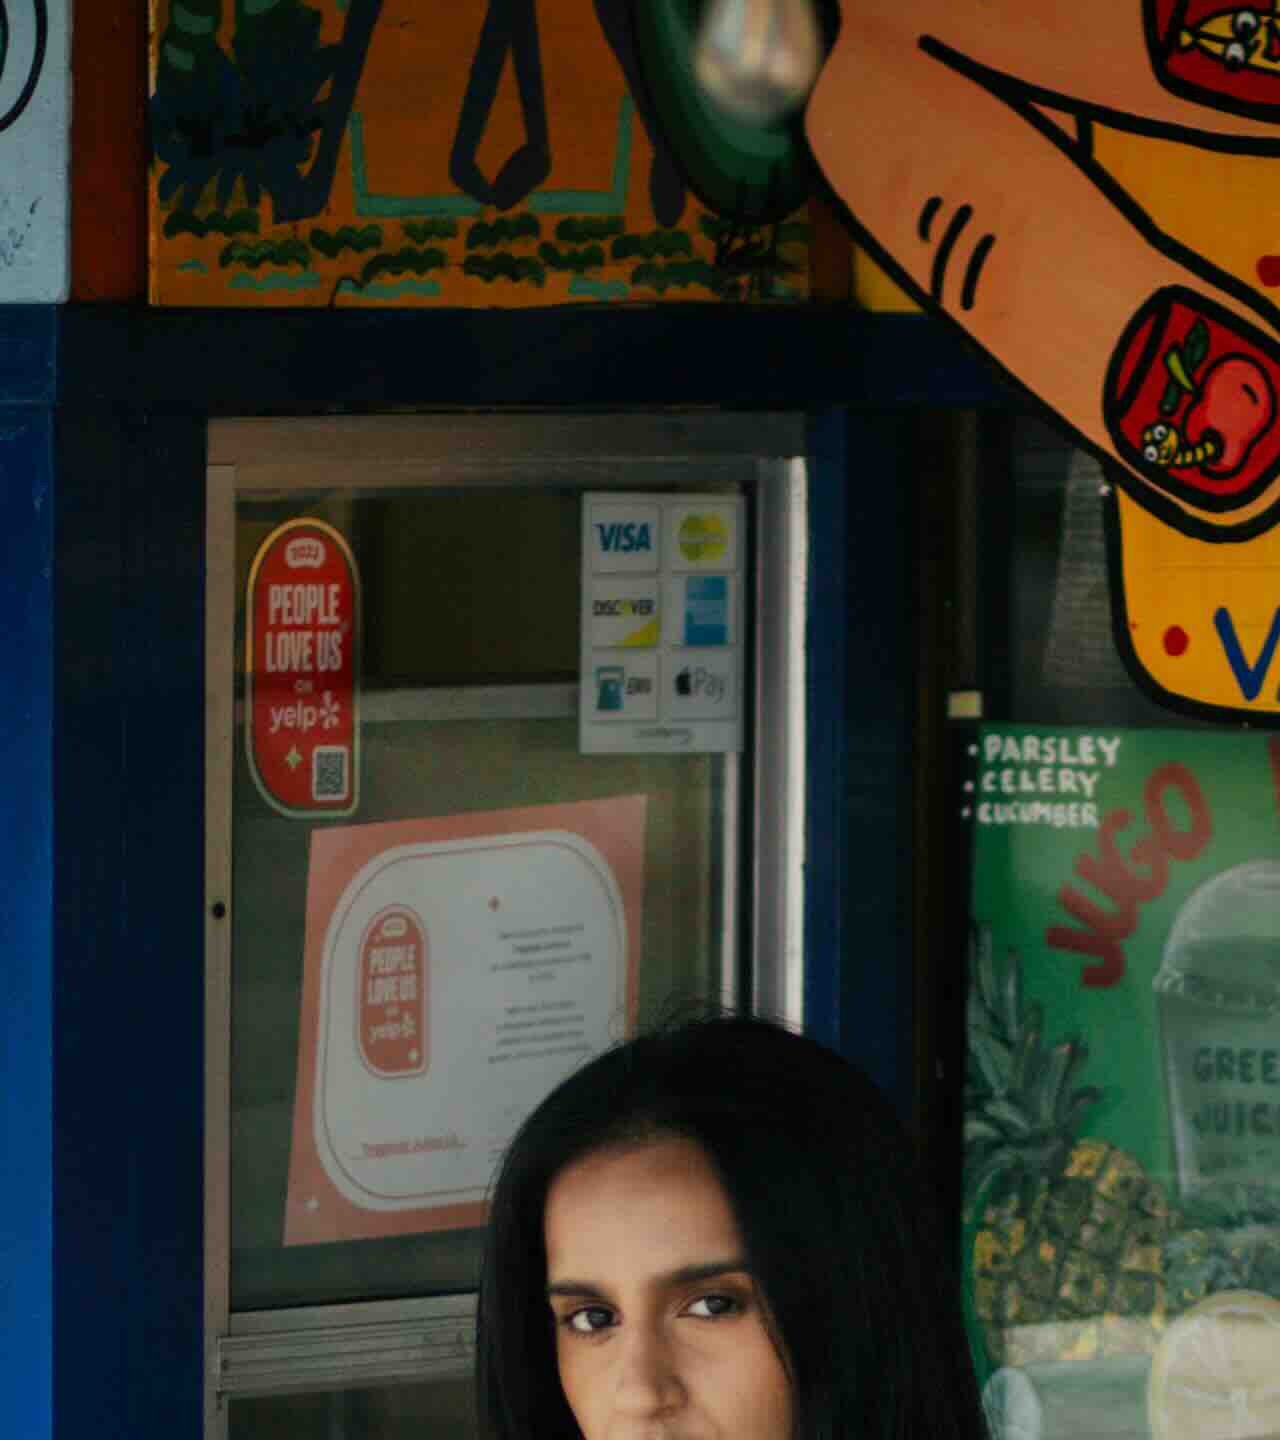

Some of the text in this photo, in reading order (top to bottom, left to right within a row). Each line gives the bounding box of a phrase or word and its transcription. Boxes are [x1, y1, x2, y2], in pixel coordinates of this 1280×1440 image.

[593, 521, 652, 553] VISA
[268, 583, 341, 625] PEOPLE
[265, 631, 342, 673] LOVE US
[269, 703, 319, 735] yelp
[984, 735, 1121, 768] PARSLEY
[980, 768, 1101, 799] CELERY
